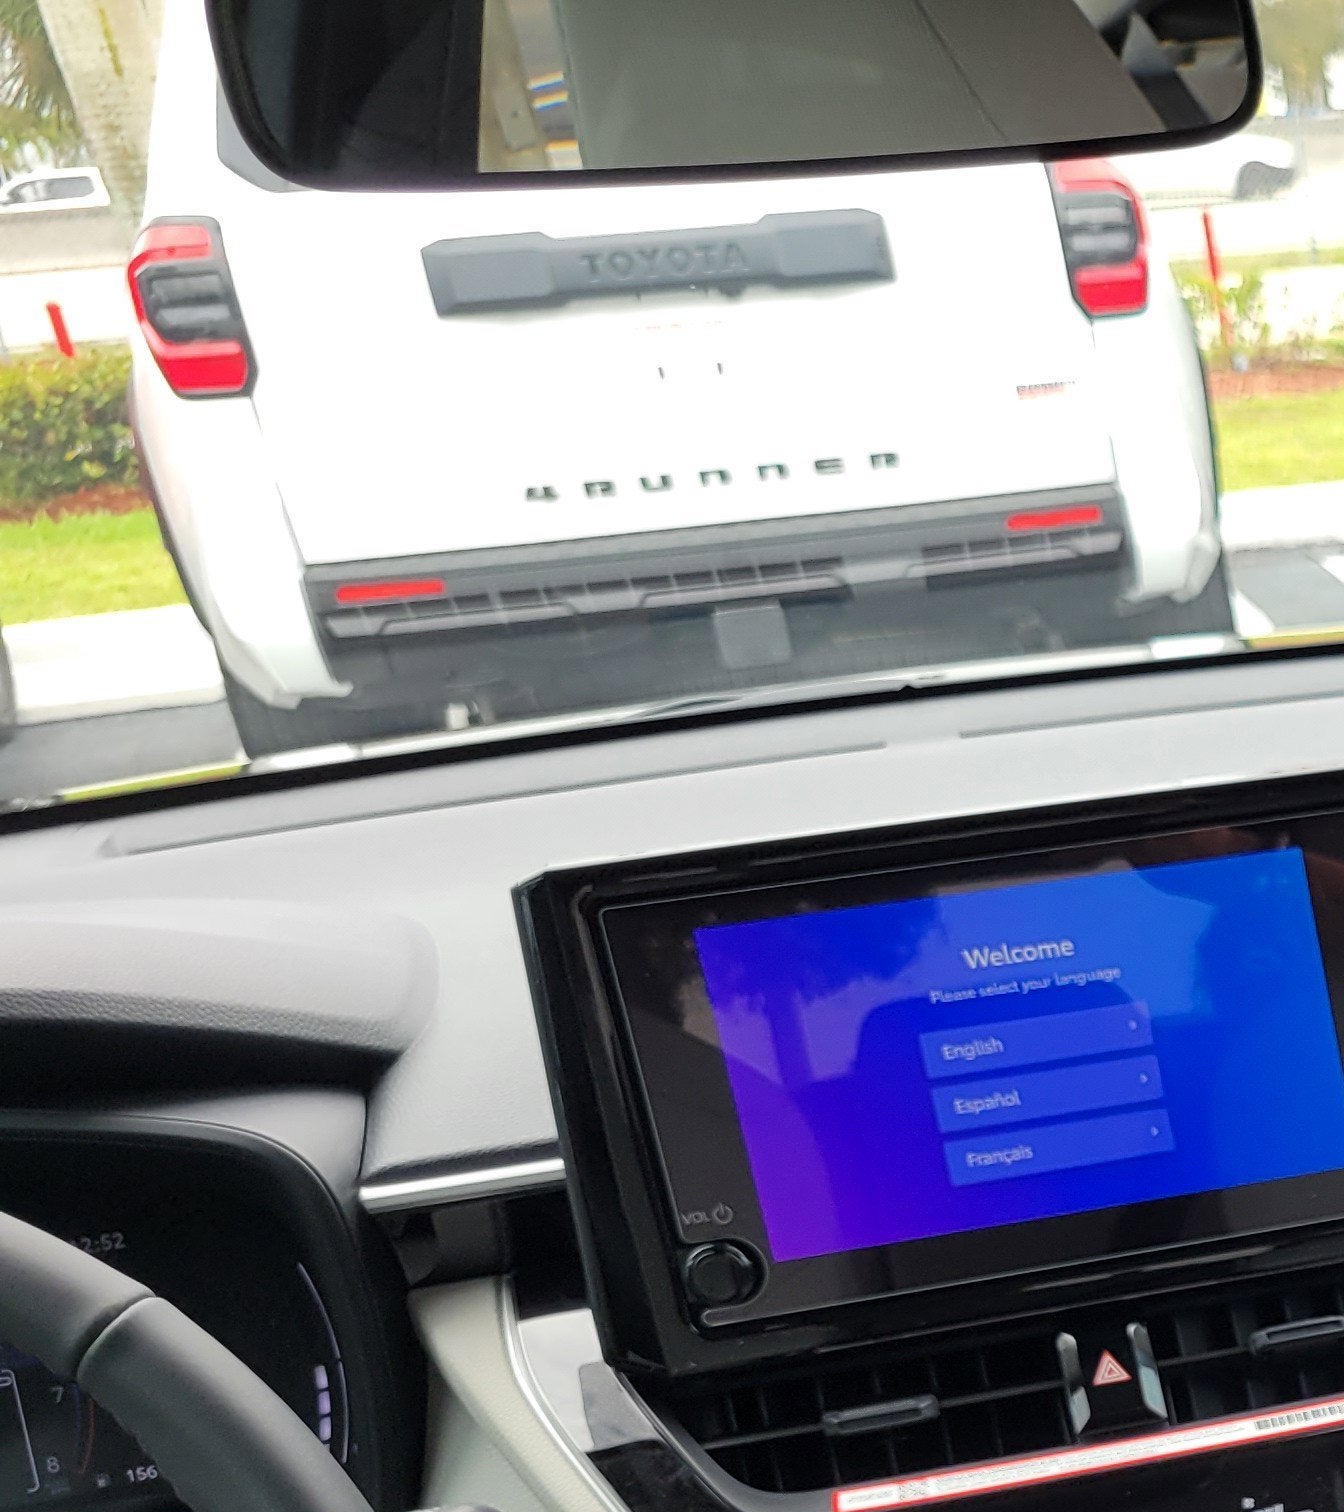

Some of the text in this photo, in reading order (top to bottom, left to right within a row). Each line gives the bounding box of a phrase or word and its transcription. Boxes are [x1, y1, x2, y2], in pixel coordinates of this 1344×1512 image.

[578, 241, 749, 281] TOYOTA
[525, 452, 900, 502] 4RUNNER
[962, 939, 1076, 970] Welcome
[929, 966, 1122, 1005] Please select your language
[941, 1035, 1005, 1061] English
[953, 1088, 1022, 1115] Español
[965, 1143, 1034, 1168] Français
[680, 1211, 710, 1226] VOL
